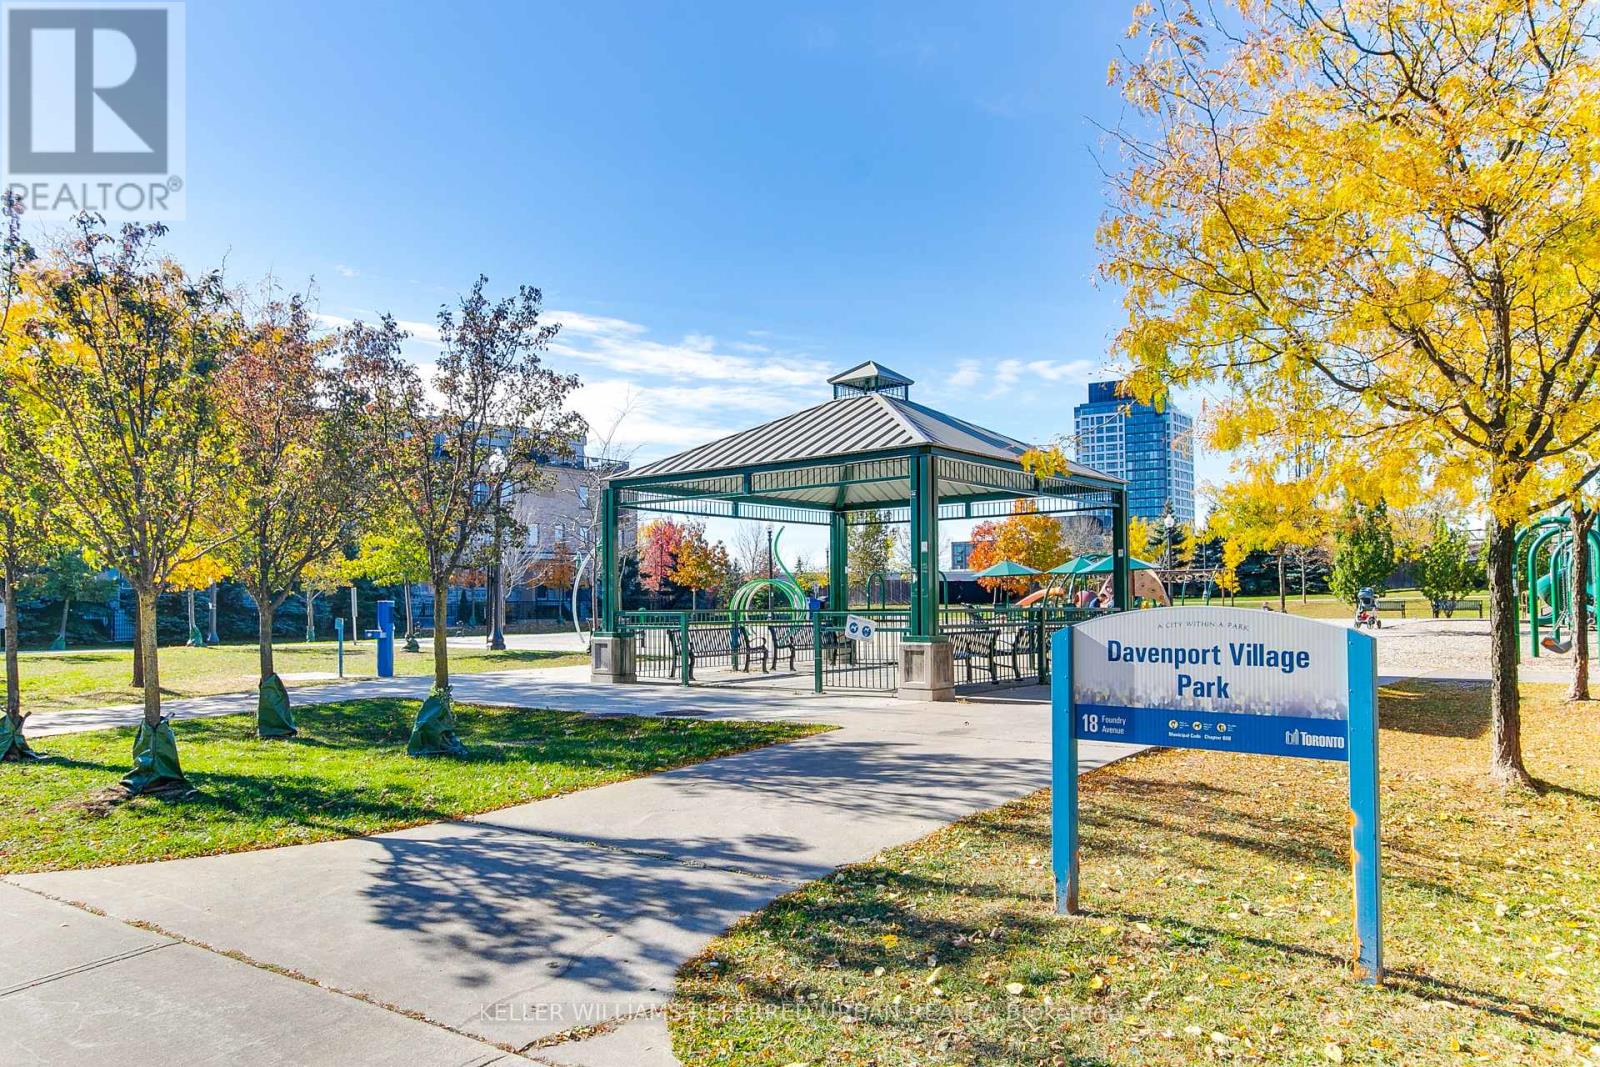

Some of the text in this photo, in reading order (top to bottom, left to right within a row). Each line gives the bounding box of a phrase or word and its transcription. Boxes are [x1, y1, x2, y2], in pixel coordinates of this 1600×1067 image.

[1165, 621, 1183, 629] CITY
[1186, 620, 1216, 628] WITHIN
[1227, 621, 1249, 632] PARK
[1107, 639, 1310, 674] Davenport Village
[1177, 674, 1230, 699] Park
[1082, 713, 1099, 733] 18
[1101, 714, 1127, 726] Foundry
[1101, 725, 1125, 735] Avenue
[1300, 731, 1345, 749] TORONTO
